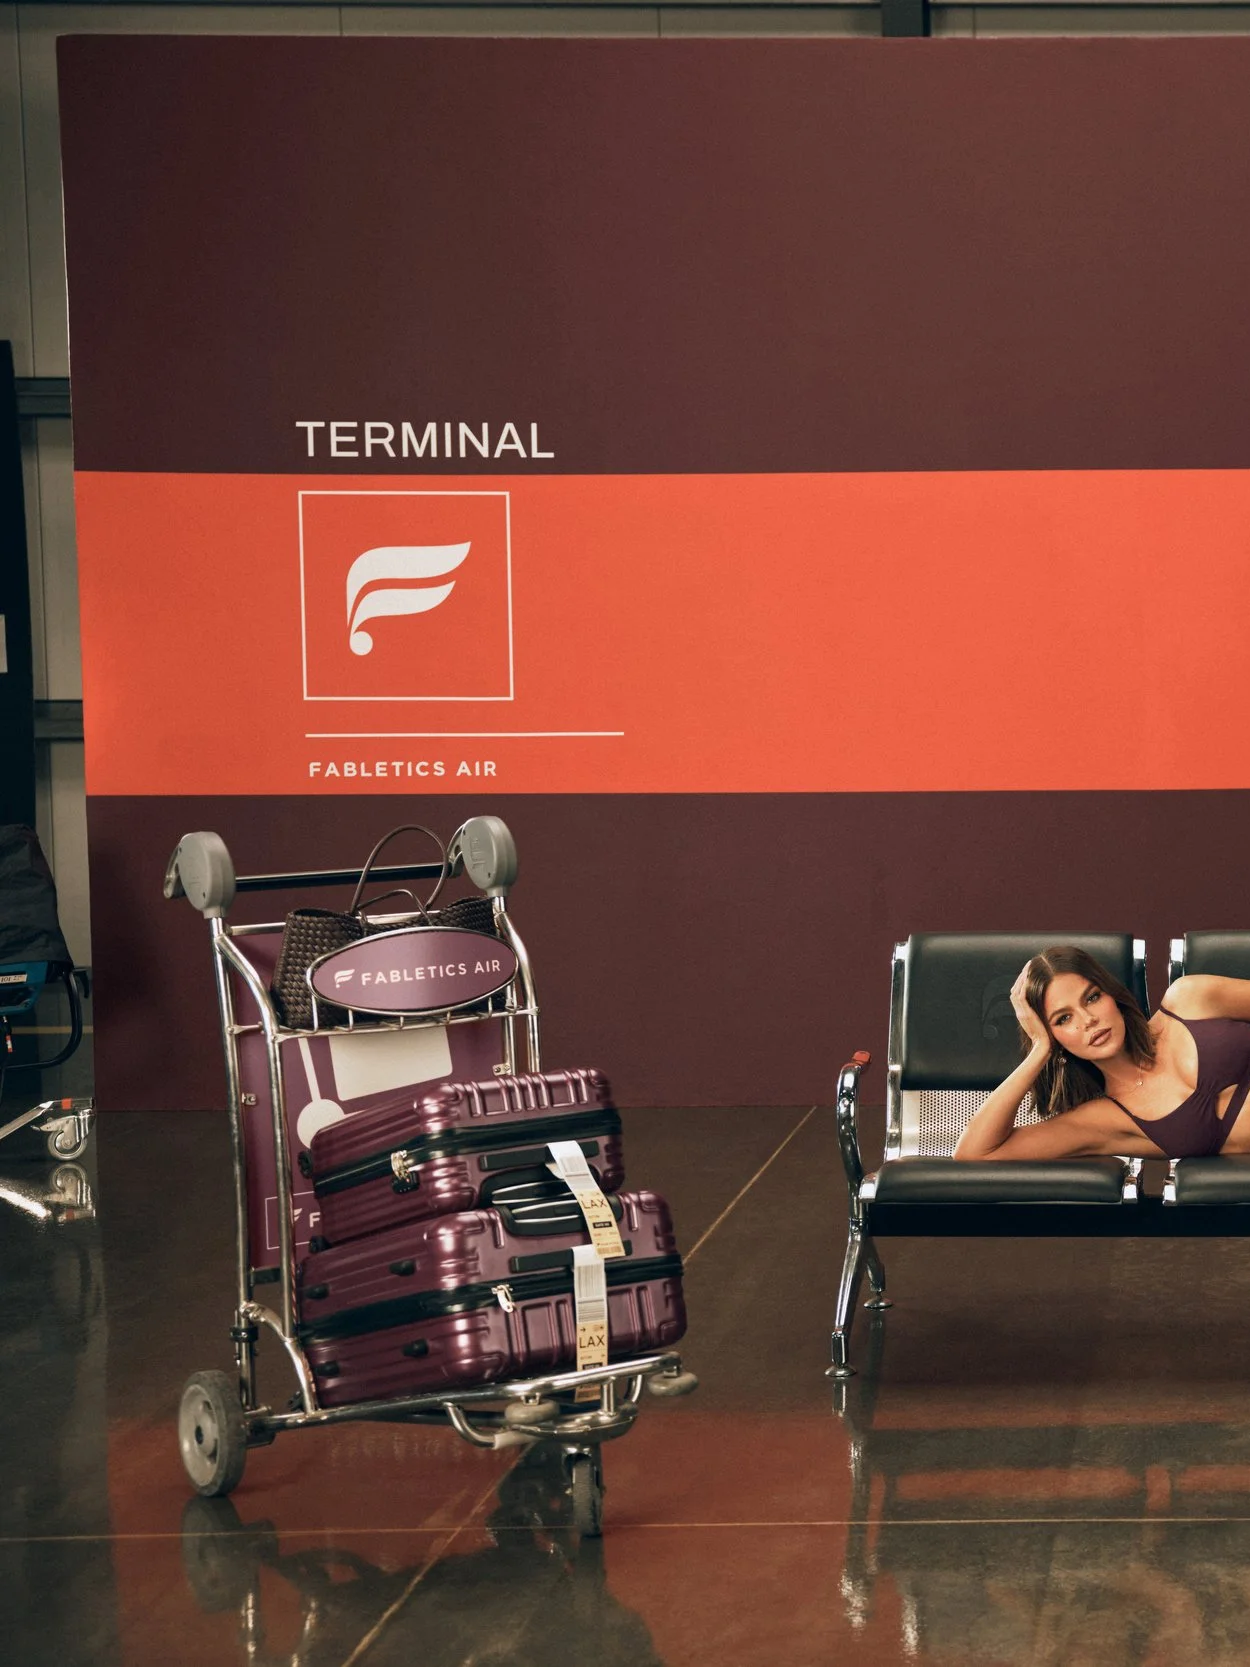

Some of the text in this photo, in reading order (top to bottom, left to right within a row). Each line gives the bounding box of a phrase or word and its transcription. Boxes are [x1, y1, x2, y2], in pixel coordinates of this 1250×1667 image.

[296, 421, 555, 459] TERMINAL
[309, 761, 497, 777] FABLETICS AIR
[361, 959, 501, 986] FABLETICS AIR
[581, 1199, 607, 1209] LAX
[579, 1334, 605, 1349] LAX
